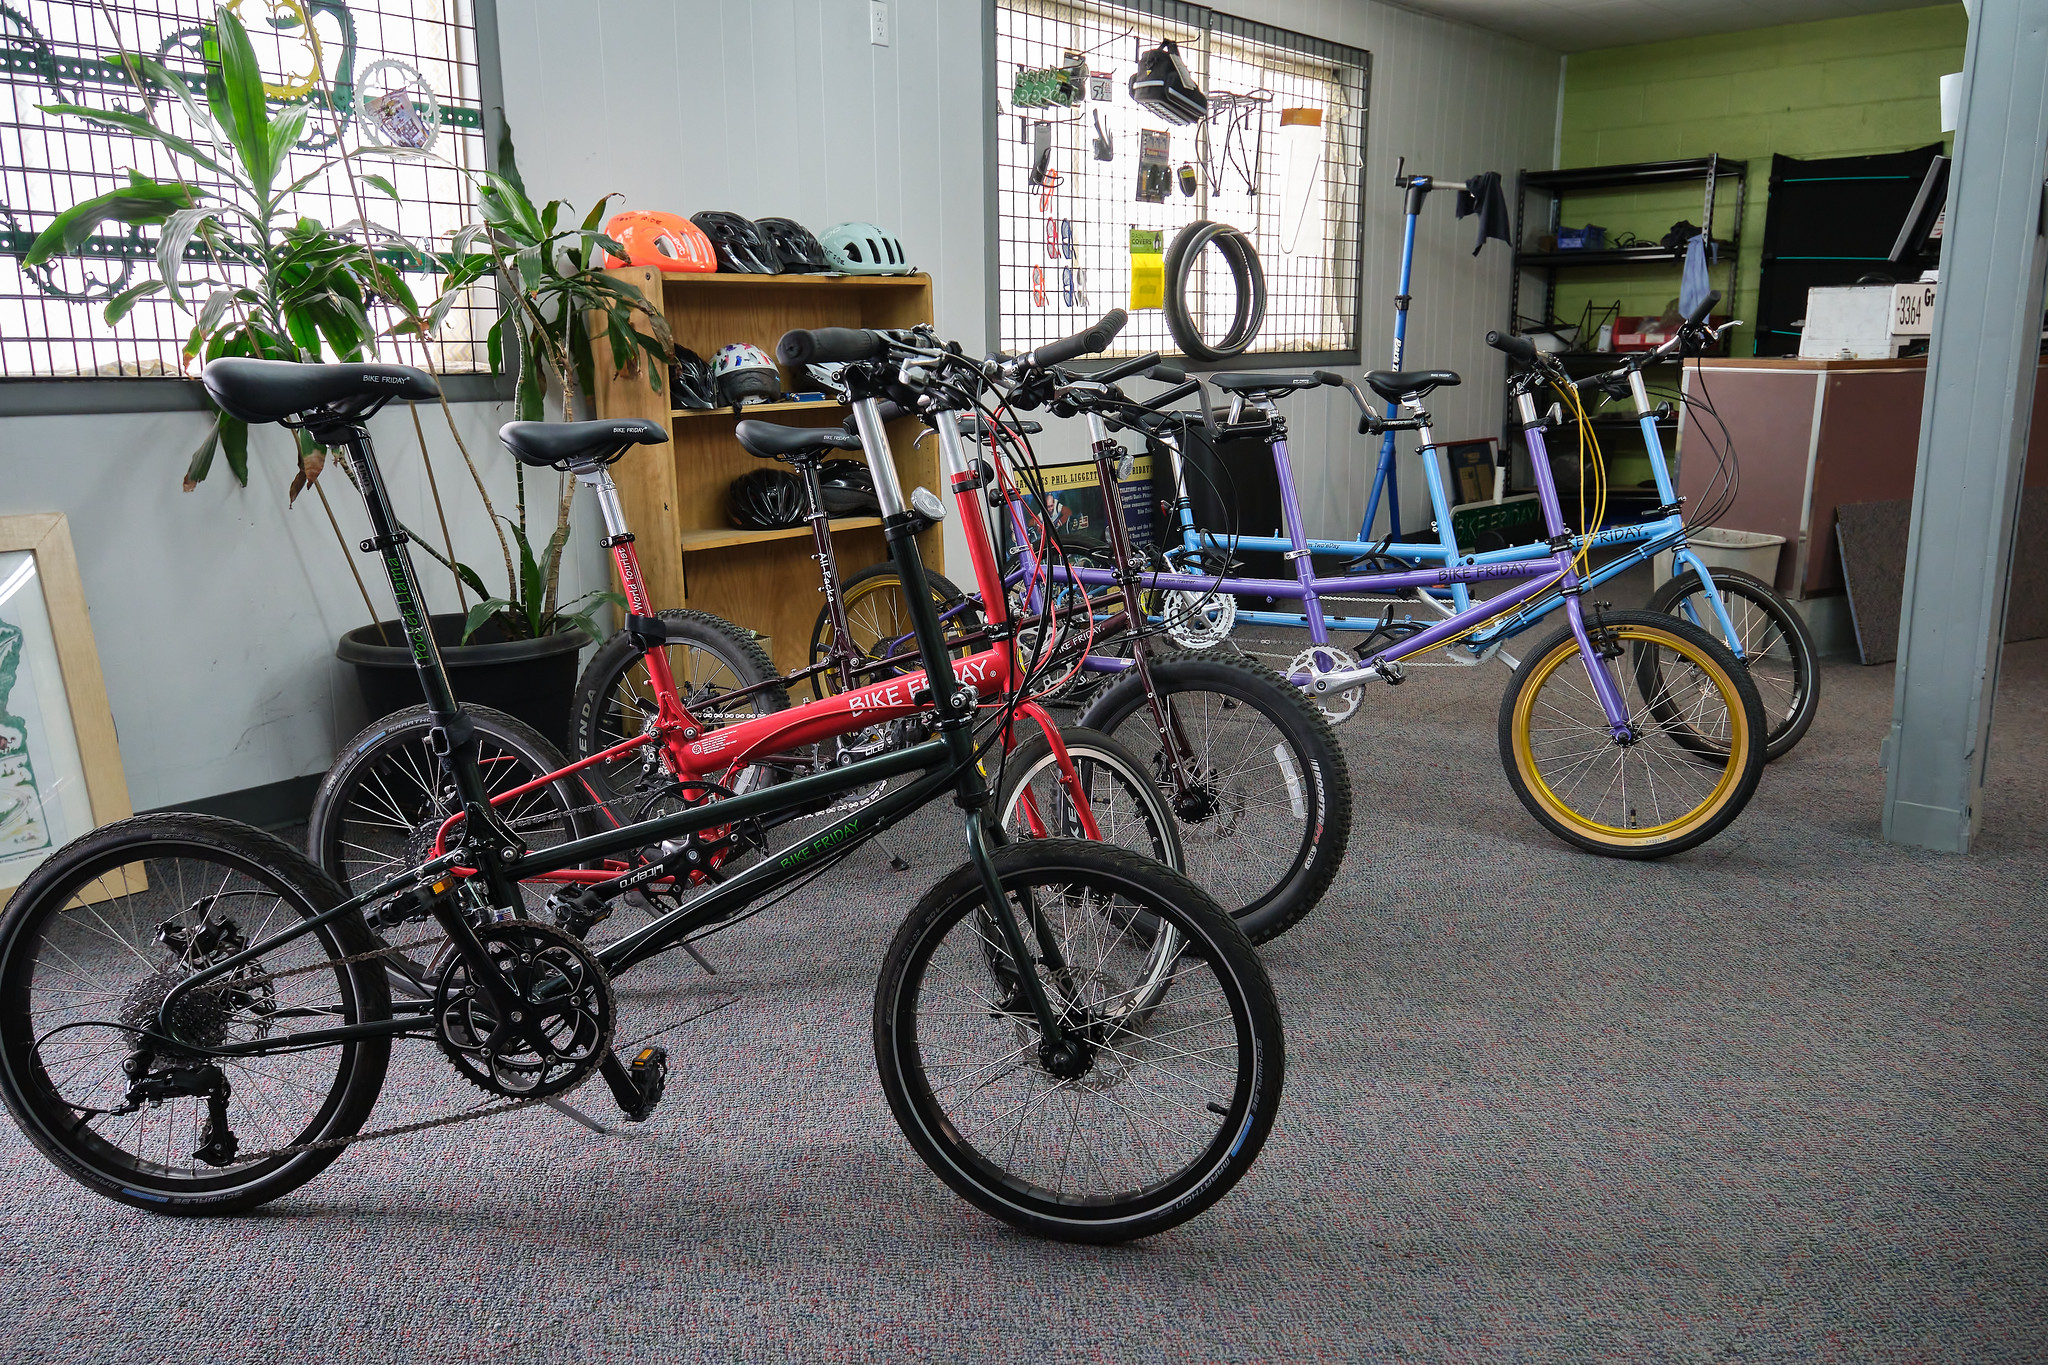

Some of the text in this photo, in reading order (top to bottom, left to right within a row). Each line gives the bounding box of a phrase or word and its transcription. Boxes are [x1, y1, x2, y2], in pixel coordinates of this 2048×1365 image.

[362, 374, 407, 385] BIKE FRIDAY
[1051, 473, 1068, 484] PHIL
[1070, 472, 1099, 483] LIGGETT
[1591, 525, 1644, 545] FRIDAY
[618, 548, 634, 582] Tourist
[1438, 562, 1531, 582] BIKE FRIDAY
[387, 557, 429, 661] Pocket Llama
[628, 583, 643, 611] World
[1072, 624, 1102, 647] FRIDAY
[849, 686, 903, 718] BIKE
[1313, 770, 1326, 825] BOOSTER
[780, 819, 860, 869] BIKE FRIDAY
[1176, 1038, 1264, 1210] SCHWALBE MARATHON
